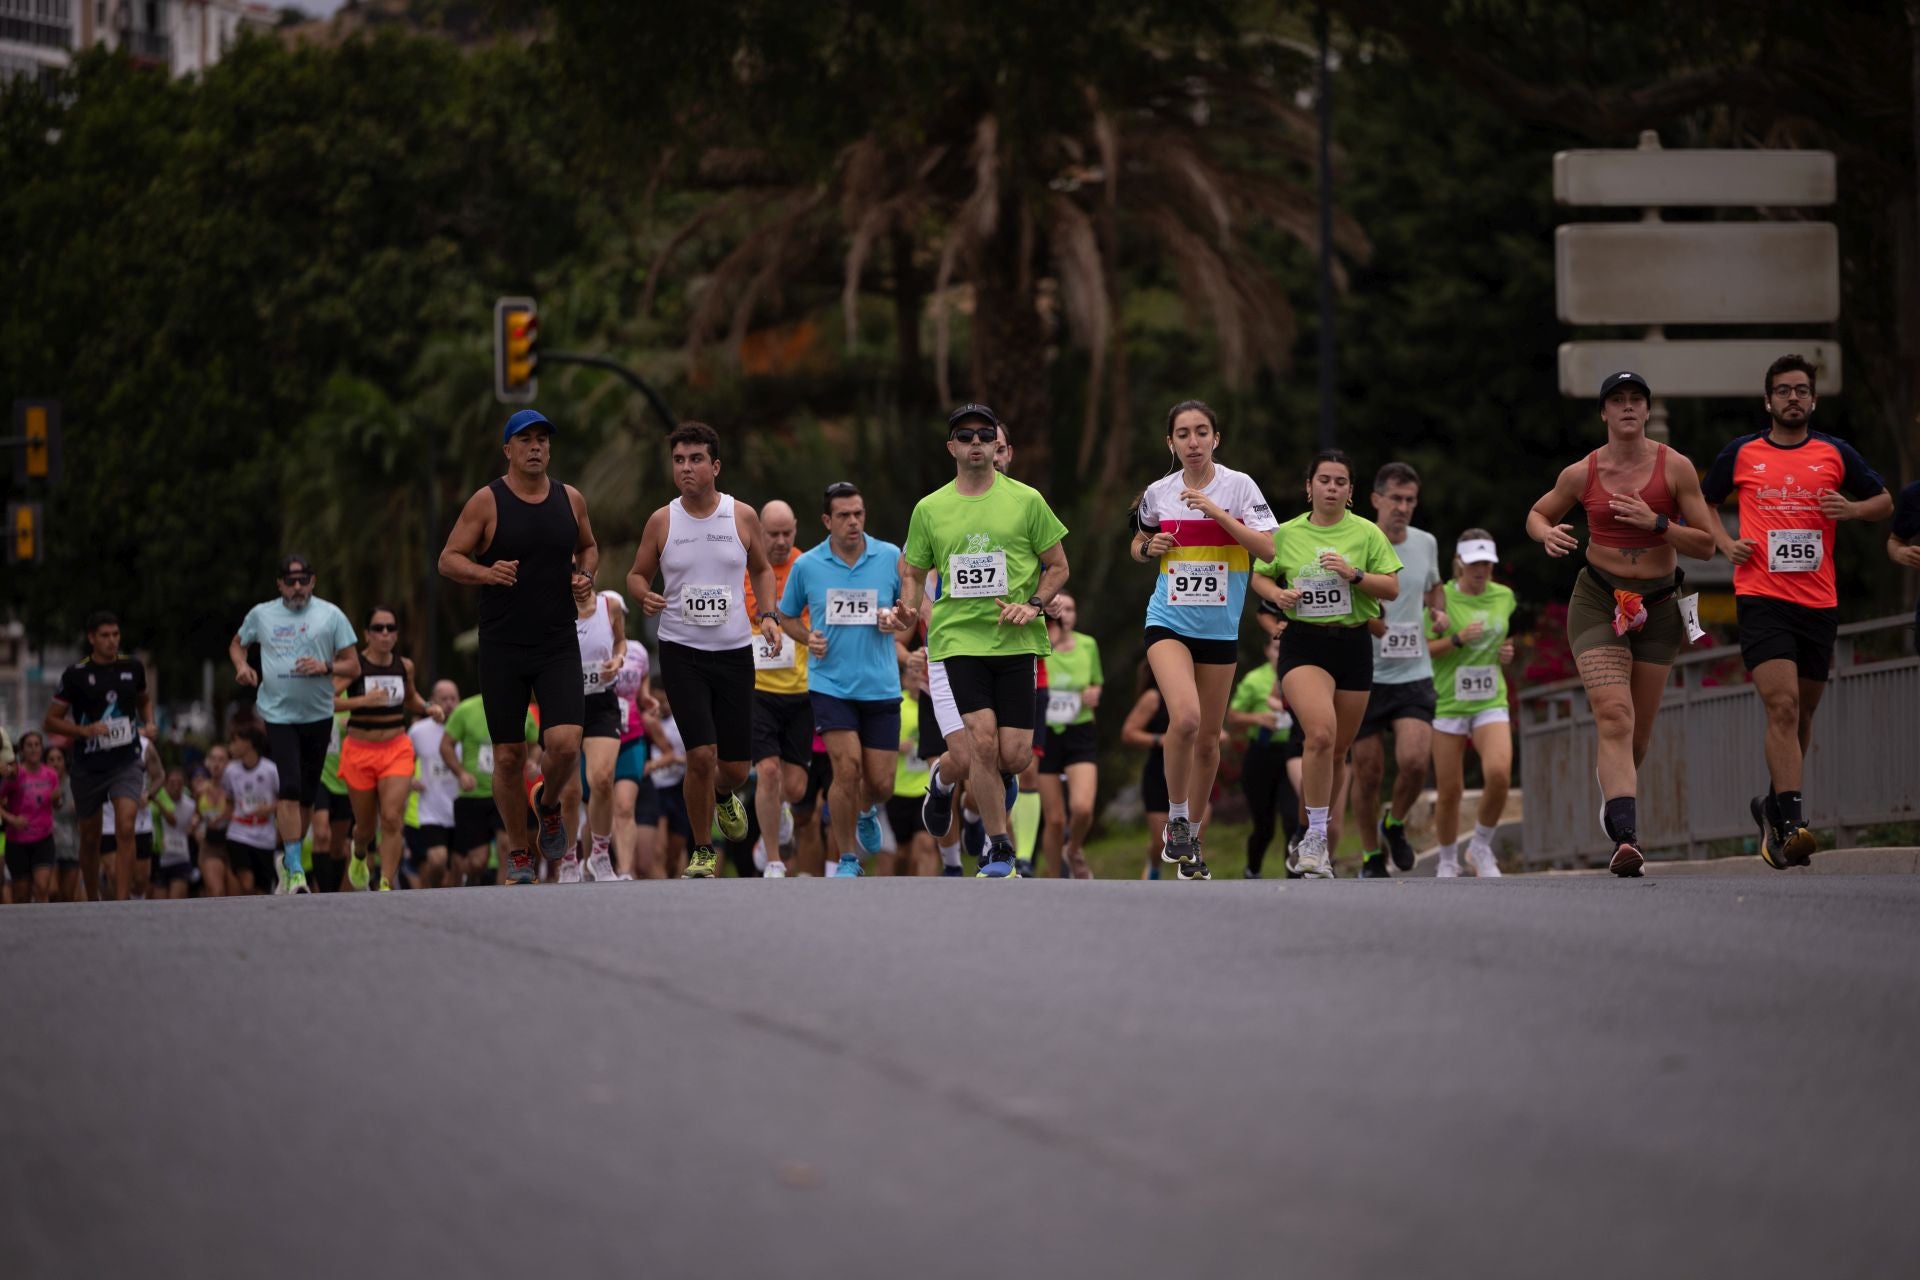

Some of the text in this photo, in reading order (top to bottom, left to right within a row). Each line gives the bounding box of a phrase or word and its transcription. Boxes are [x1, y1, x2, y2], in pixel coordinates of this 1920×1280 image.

[1776, 544, 1815, 559] 456
[957, 567, 996, 585] 637
[1176, 576, 1217, 592] 979
[1302, 589, 1341, 605] 950
[686, 598, 727, 611] 1013
[834, 601, 868, 614] 715
[1388, 634, 1417, 648] 978
[1461, 676, 1493, 690] 910
